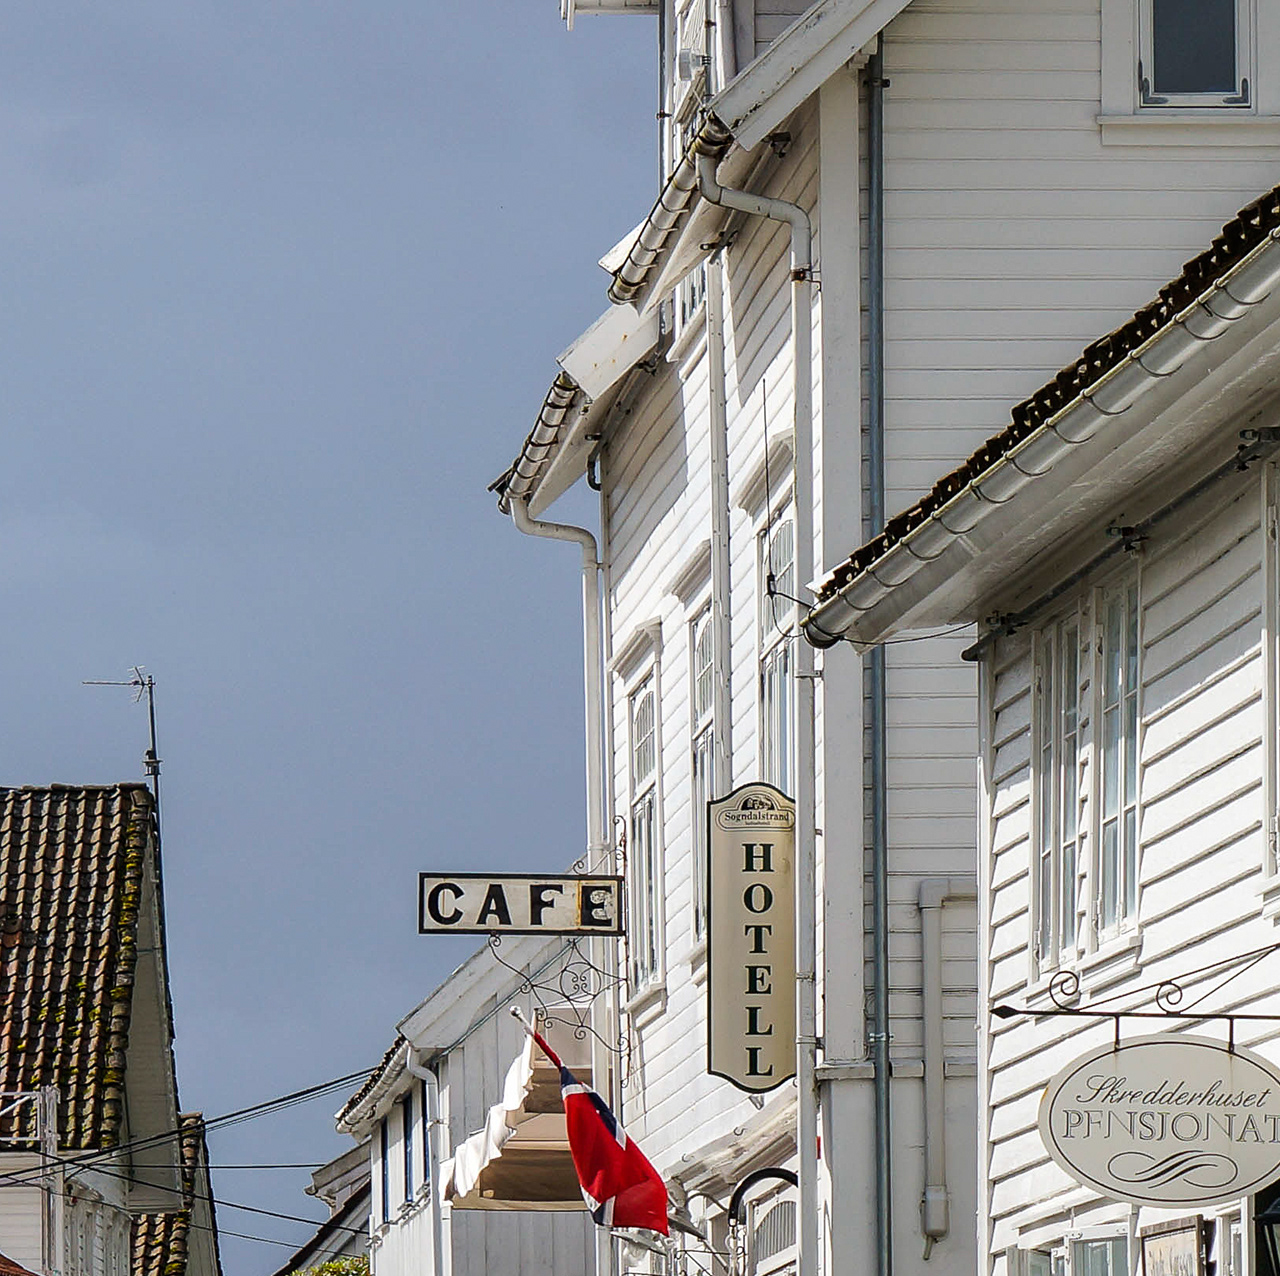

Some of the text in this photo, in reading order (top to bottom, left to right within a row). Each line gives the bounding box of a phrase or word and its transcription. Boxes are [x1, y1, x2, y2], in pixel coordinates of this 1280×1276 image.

[724, 811, 789, 823] Sogndalstrand
[427, 882, 613, 927] CAFE
[741, 843, 775, 1077] HOTELL
[1076, 1074, 1272, 1108] Skredderhuset
